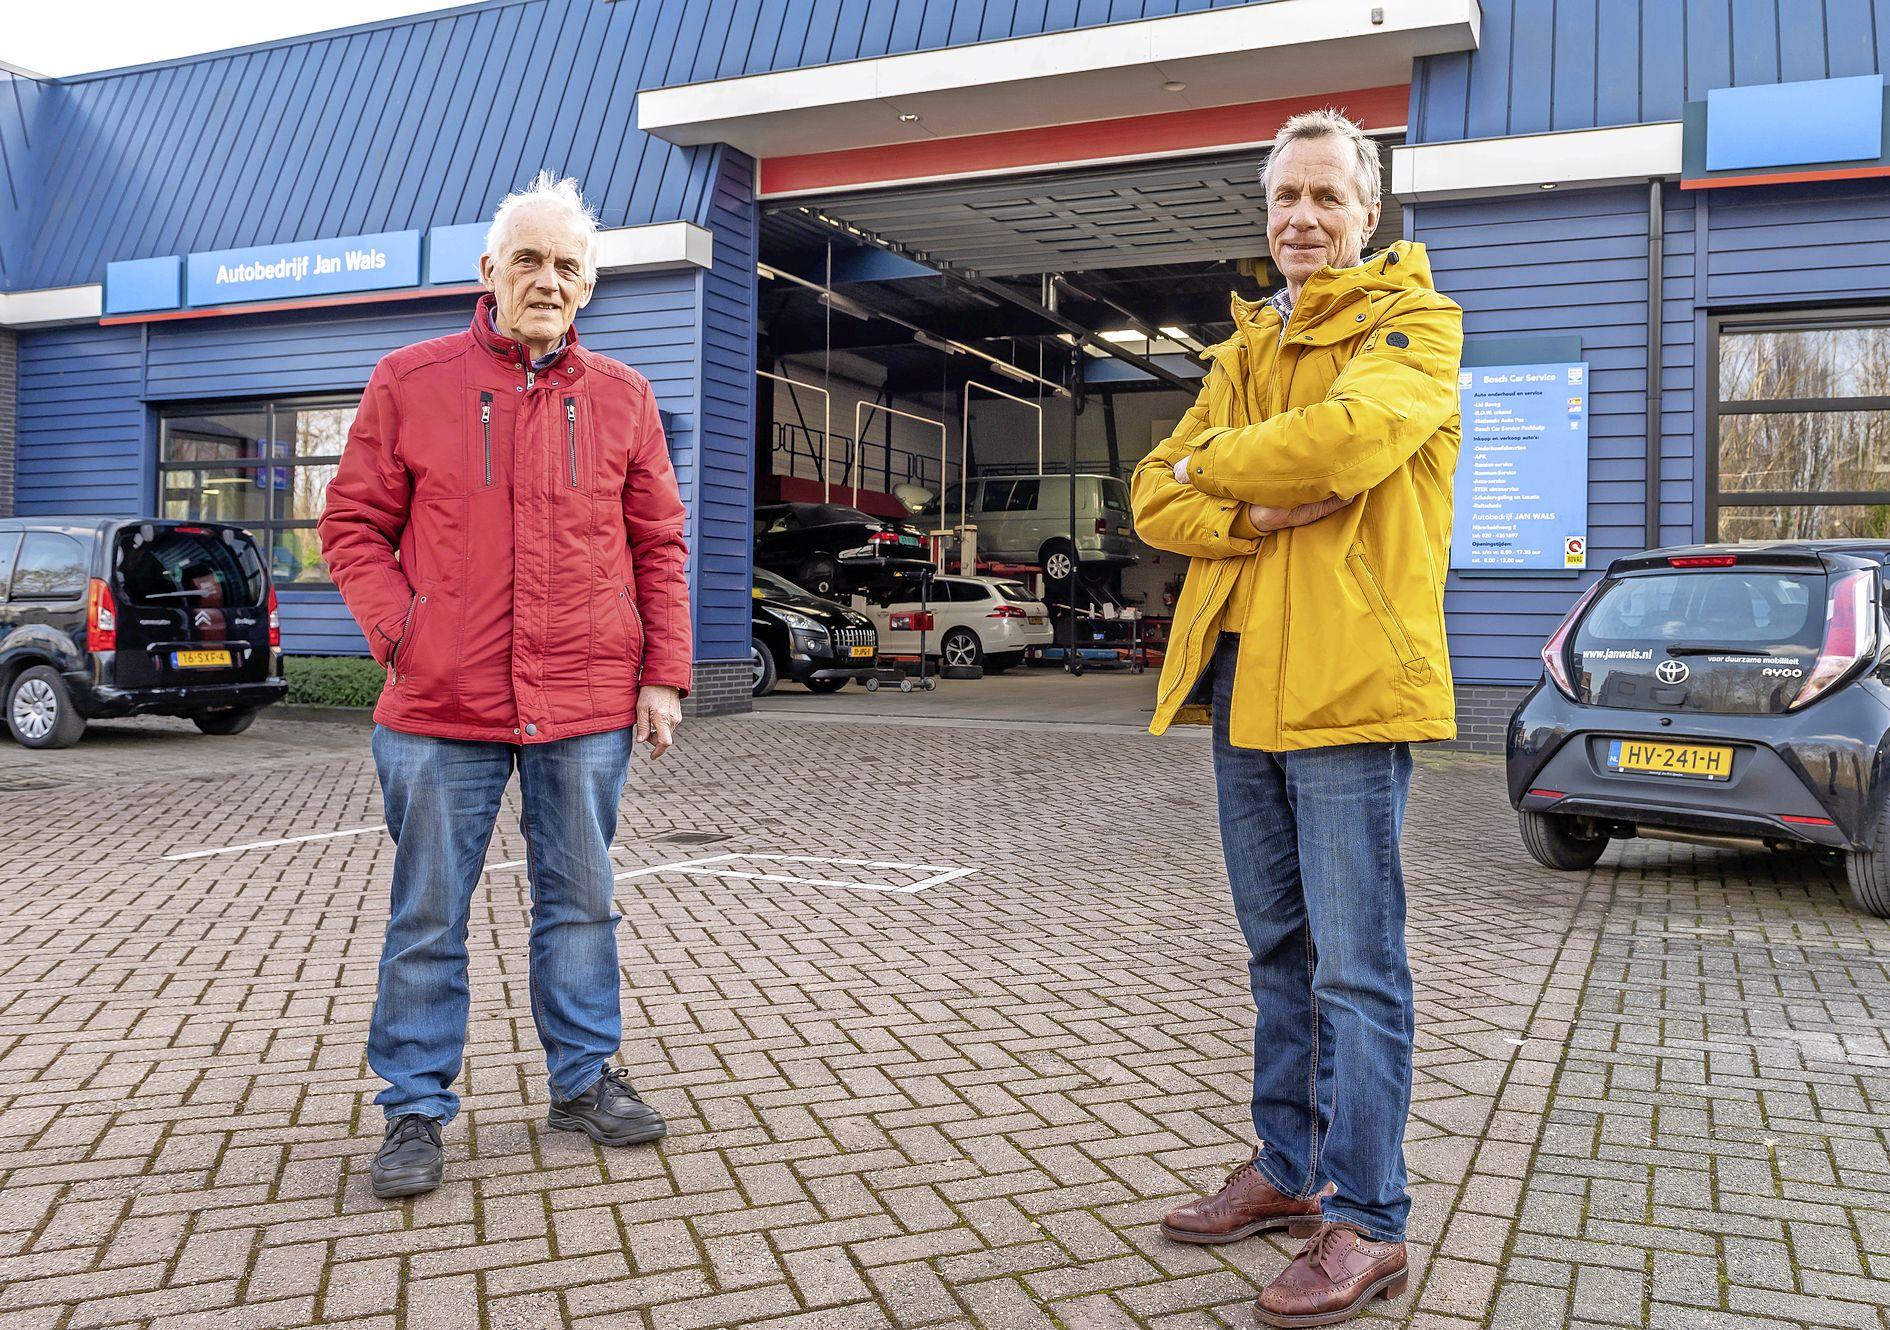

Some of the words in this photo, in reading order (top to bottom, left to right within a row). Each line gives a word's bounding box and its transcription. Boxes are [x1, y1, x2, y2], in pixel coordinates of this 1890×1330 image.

[216, 255, 309, 284] Autobedrijf
[313, 254, 342, 275] Jan
[345, 249, 386, 272] Wals
[1483, 375, 1508, 384] Bosch
[1509, 374, 1524, 382] Car
[1525, 373, 1556, 382] Service
[1472, 513, 1513, 521] Autobedrijf
[1532, 512, 1556, 520] WALS
[182, 653, 225, 664] 16-SXF-4
[1582, 648, 1653, 661] www.janwals.nl
[1724, 655, 1762, 664] duurzame
[1762, 656, 1800, 665] mobiliteit
[1762, 667, 1803, 678] AYGO
[1609, 755, 1619, 763] NL
[1627, 745, 1721, 771] HV-241-H
